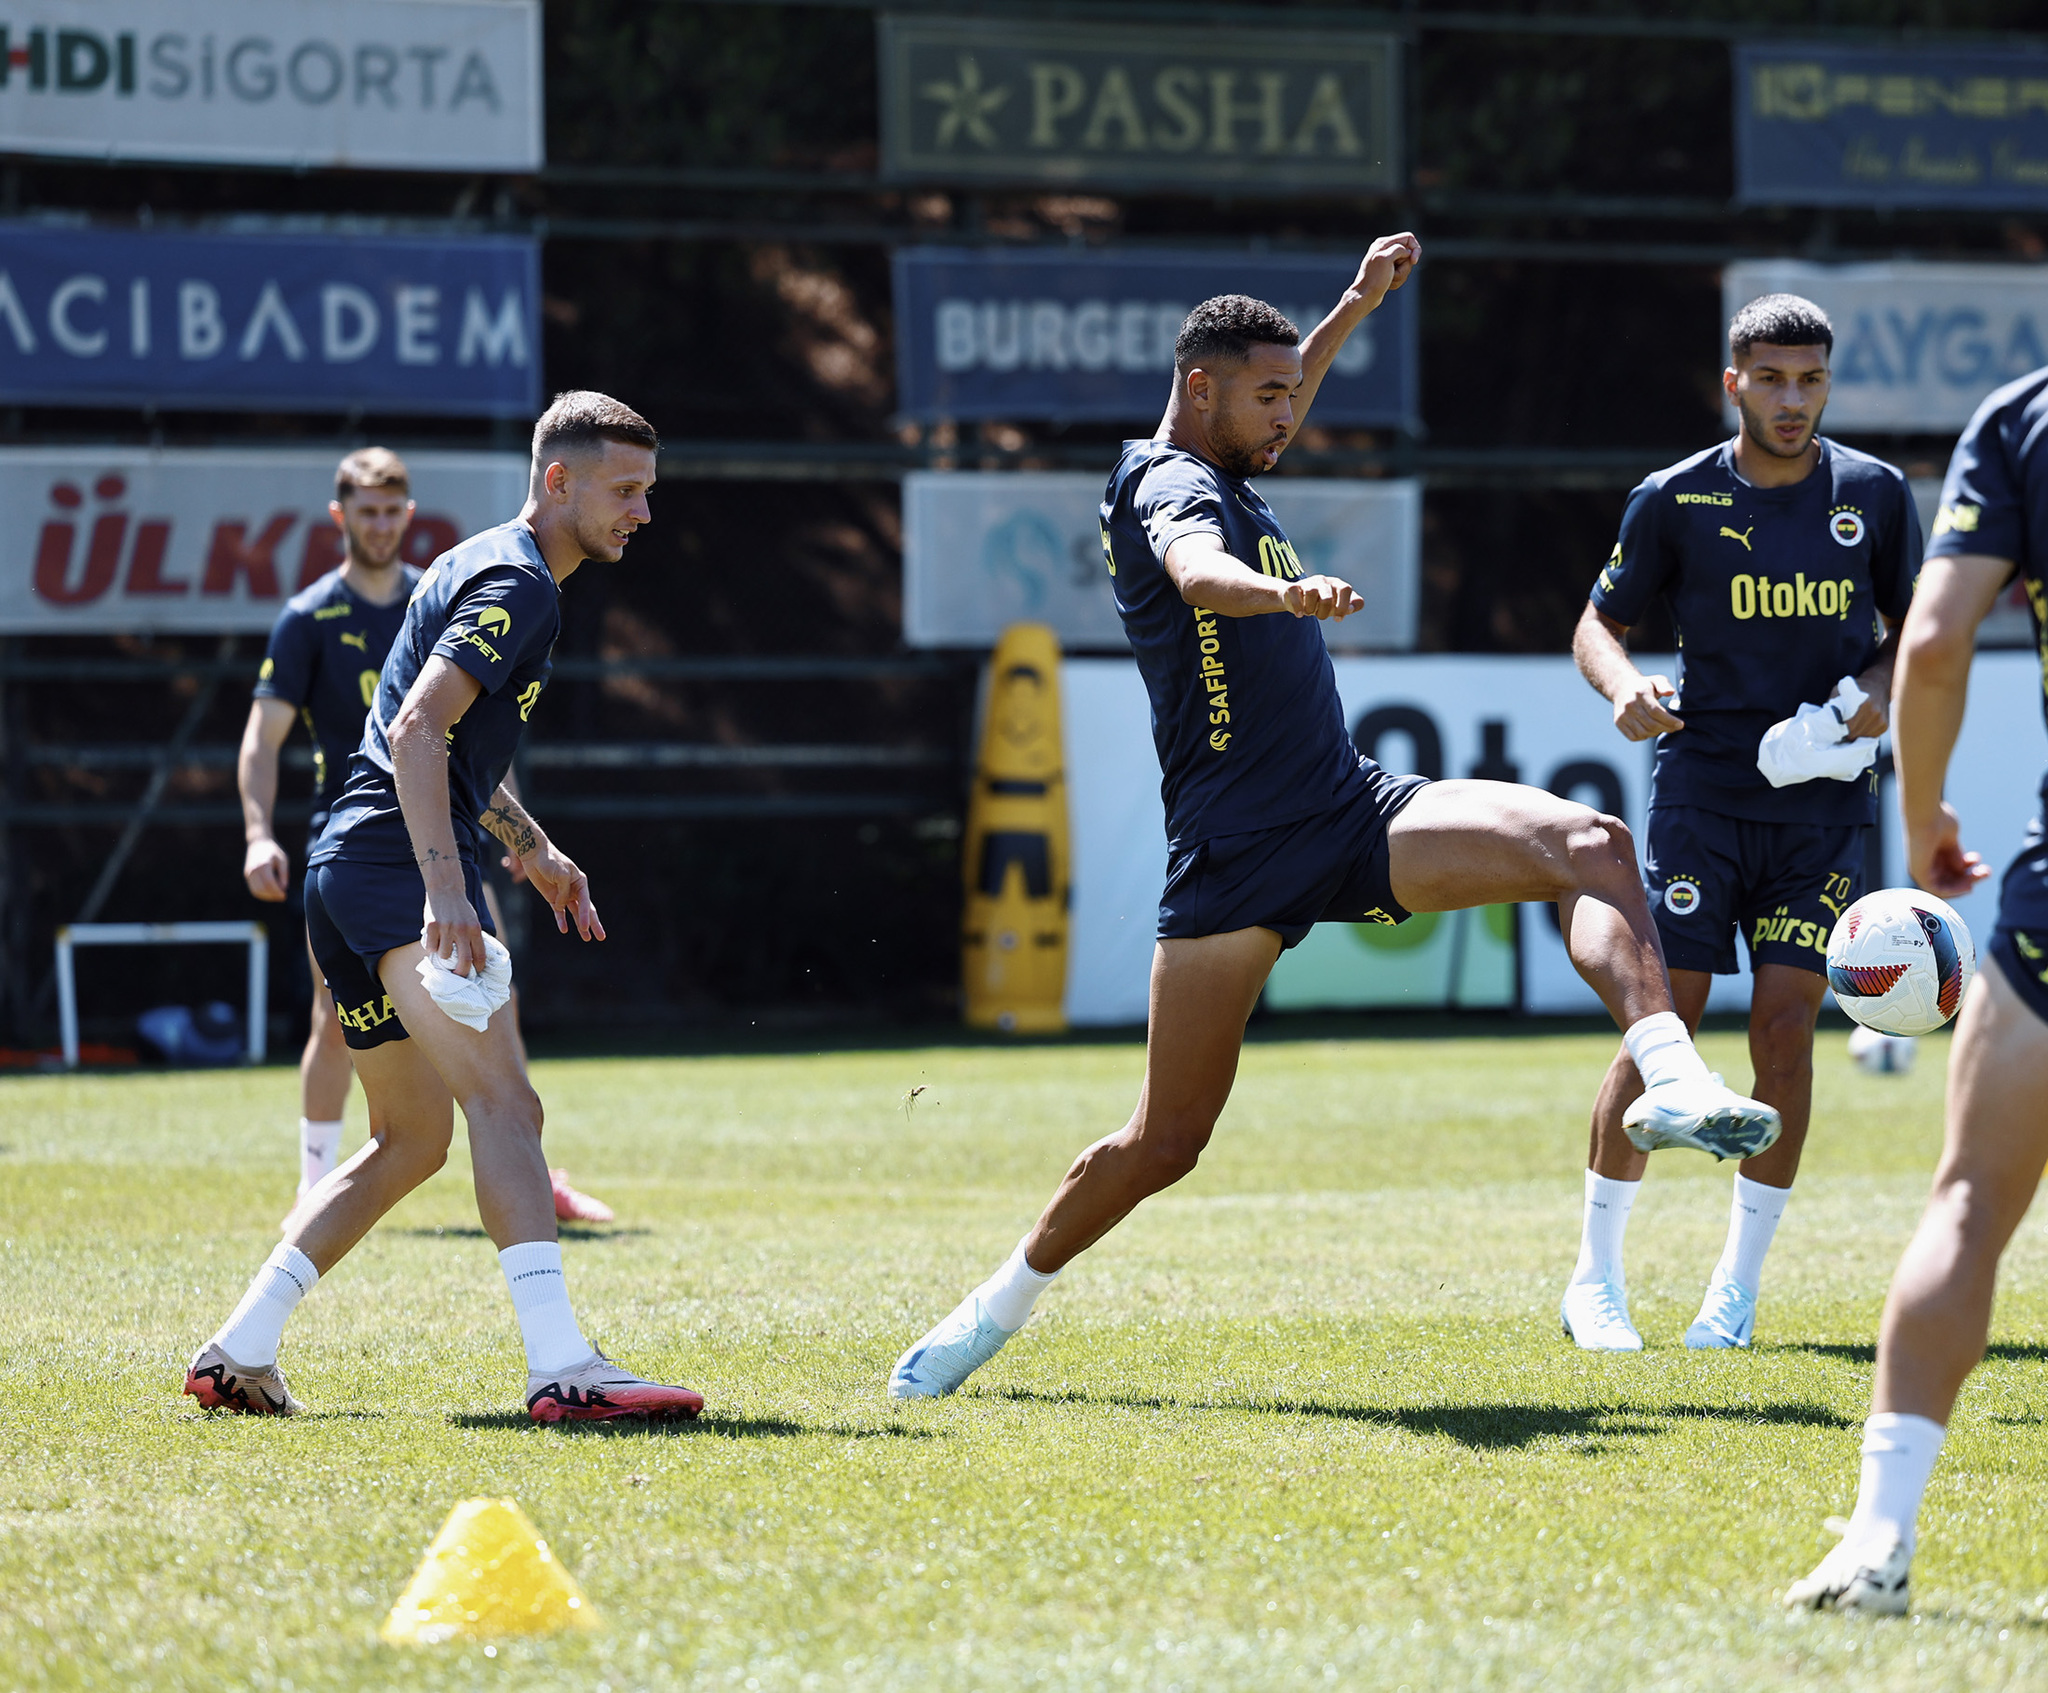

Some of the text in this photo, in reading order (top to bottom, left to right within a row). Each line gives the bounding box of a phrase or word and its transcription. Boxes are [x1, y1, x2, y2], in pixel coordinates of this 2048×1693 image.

[1027, 60, 1364, 157] PASHA
[1675, 494, 1733, 506] WORLD
[1731, 572, 1855, 621] Otokoç
[1824, 872, 1851, 900] 70
